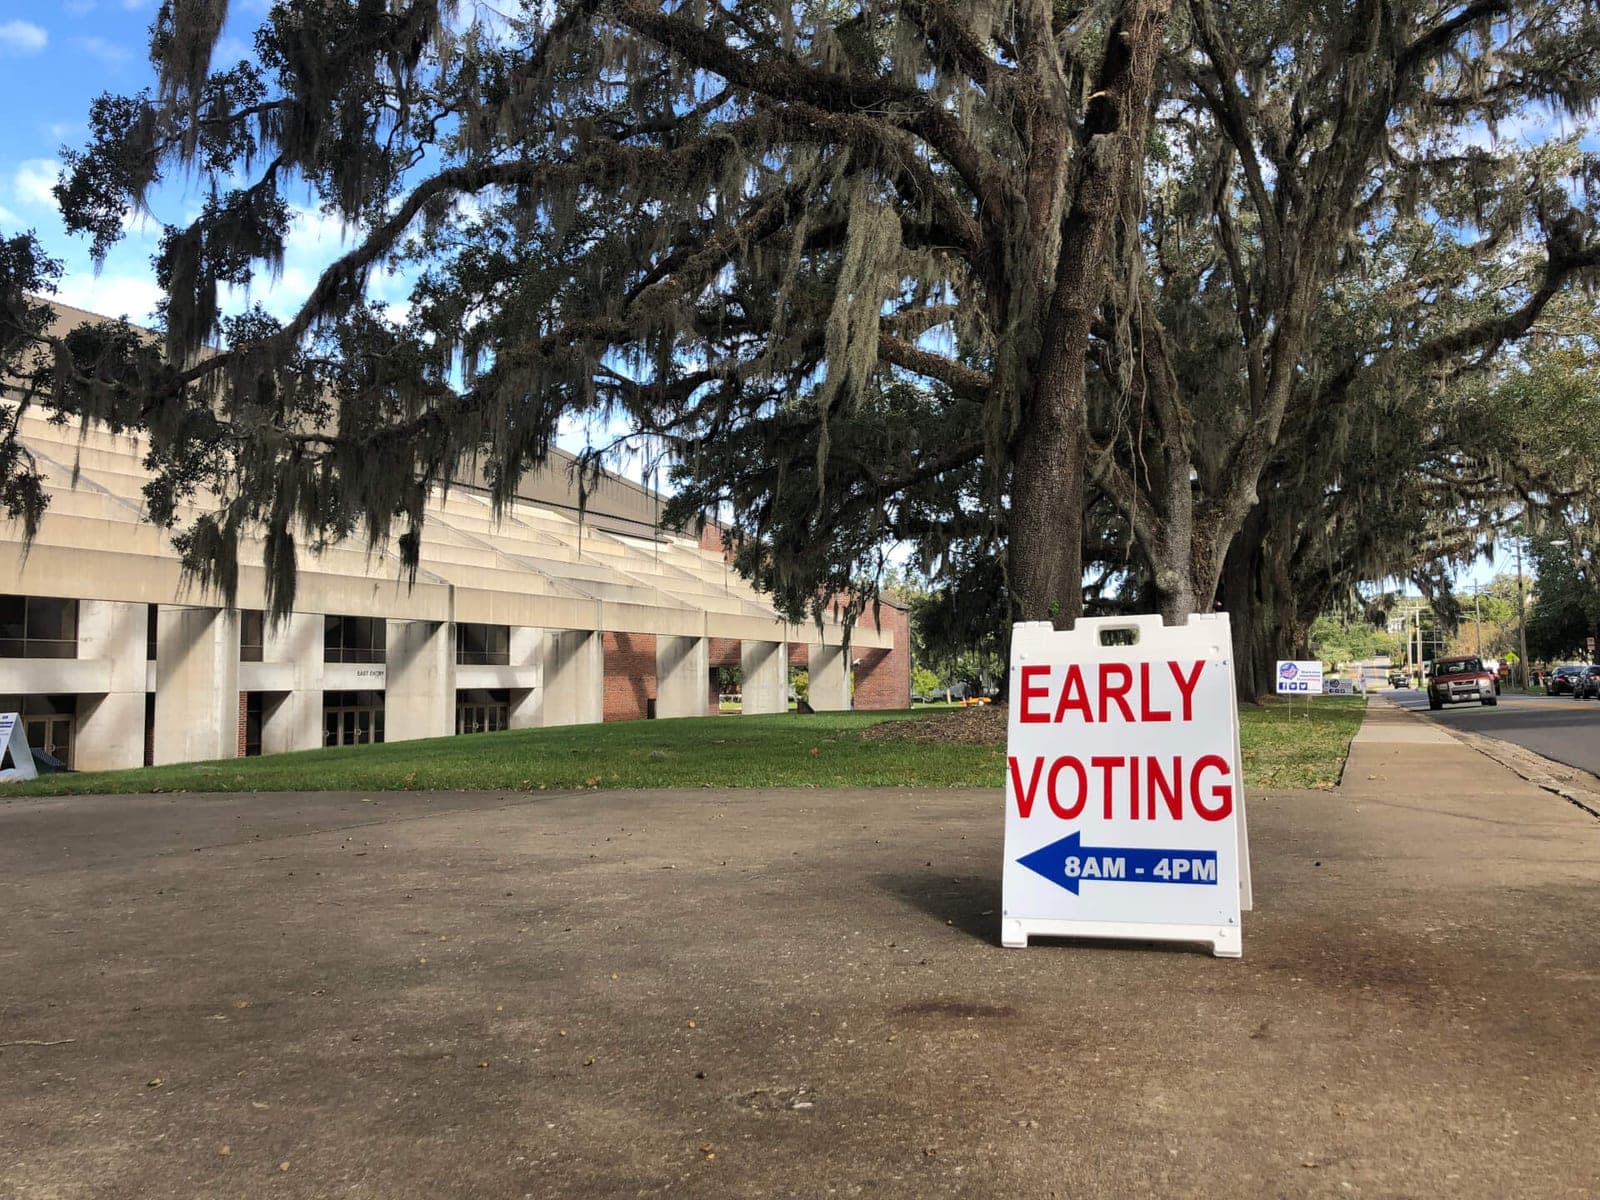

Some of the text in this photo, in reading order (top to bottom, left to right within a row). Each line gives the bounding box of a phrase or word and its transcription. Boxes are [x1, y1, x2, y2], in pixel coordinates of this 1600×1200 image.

[1020, 660, 1205, 723] EARLY
[1008, 755, 1233, 821] VOTING
[1064, 856, 1126, 878] 8AM
[1153, 857, 1216, 881] 4PM
